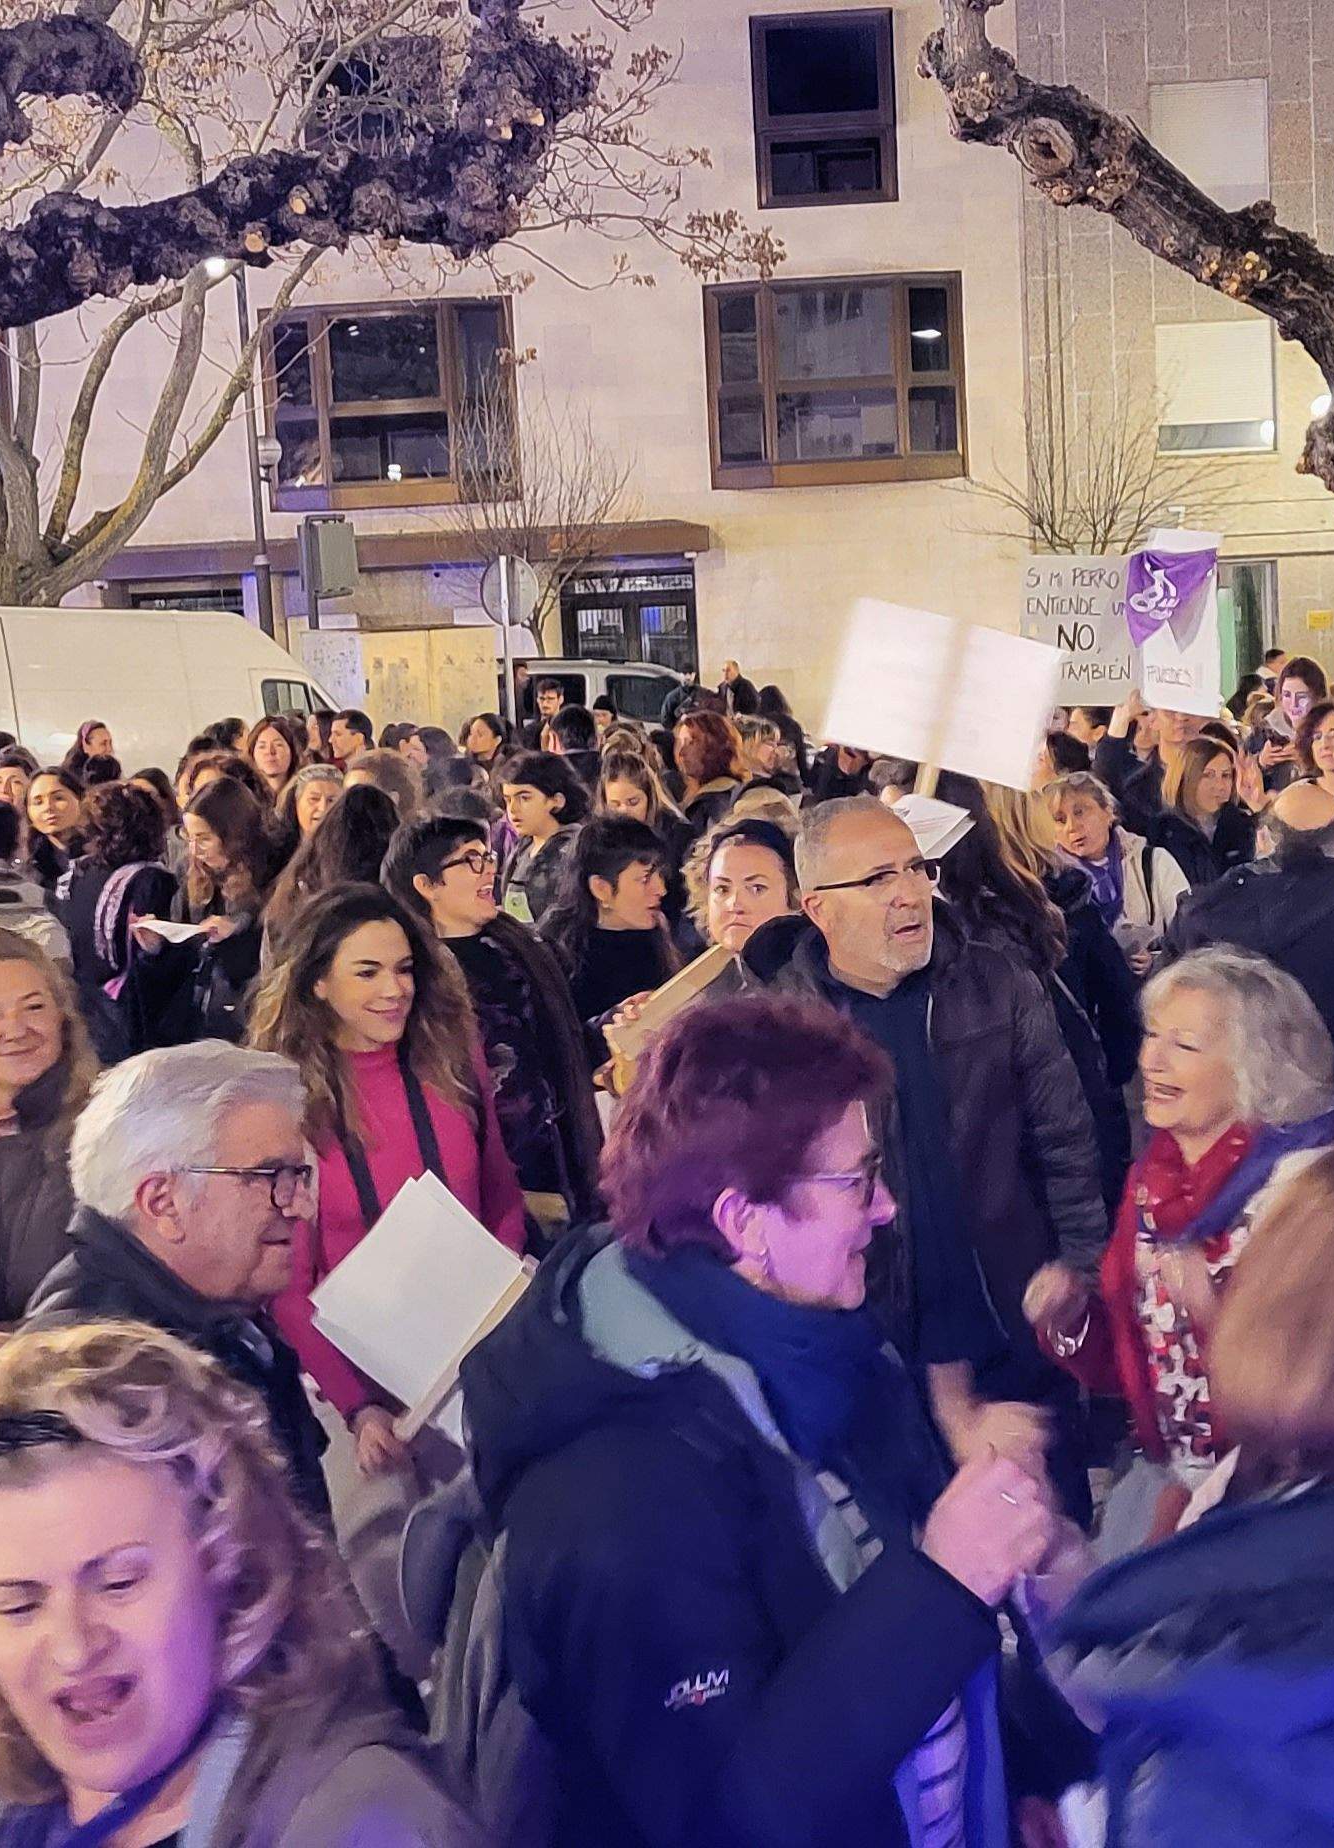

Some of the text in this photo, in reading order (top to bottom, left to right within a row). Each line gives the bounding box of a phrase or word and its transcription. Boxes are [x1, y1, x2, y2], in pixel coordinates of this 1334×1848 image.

[1072, 567, 1120, 589] PERRO
[1026, 593, 1101, 616] ENTIENDE
[1057, 621, 1101, 654] NO,
[1061, 654, 1131, 684] TAMBIÉN
